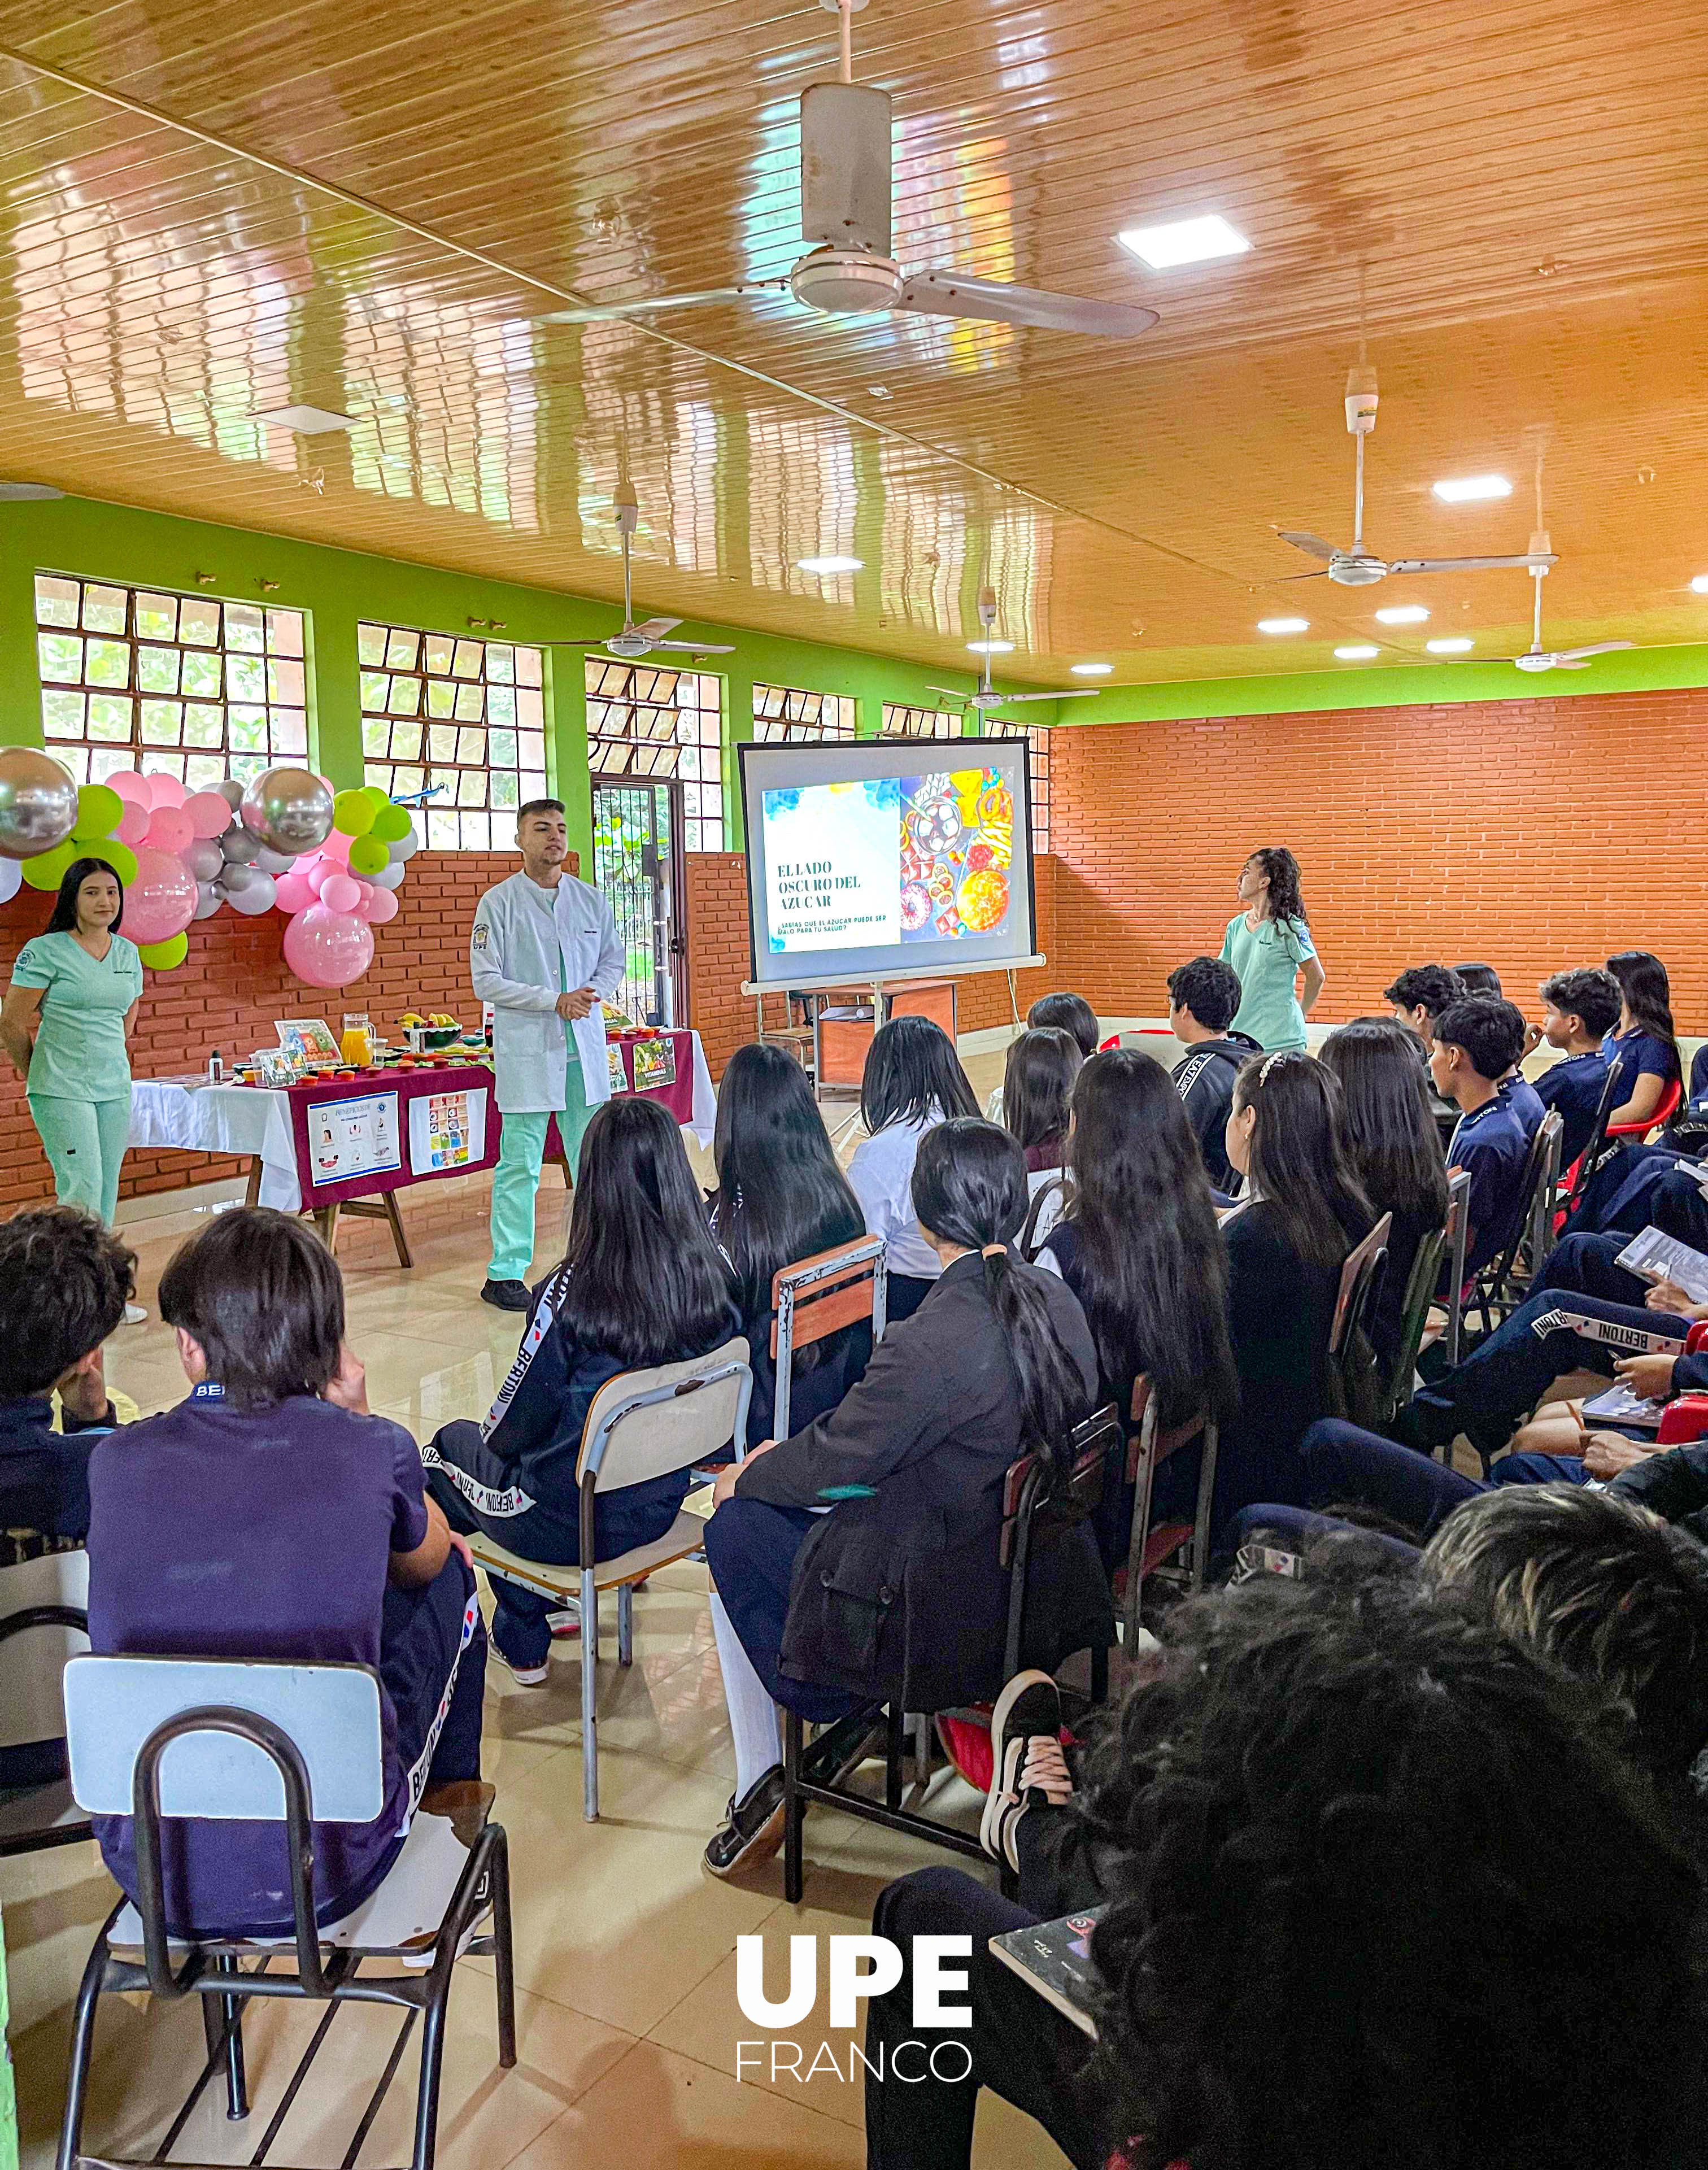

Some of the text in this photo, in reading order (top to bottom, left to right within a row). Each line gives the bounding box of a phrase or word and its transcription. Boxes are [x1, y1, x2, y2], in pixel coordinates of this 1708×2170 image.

[778, 861, 832, 877] EL LADO
[778, 876, 861, 894] OSCURO DEL
[781, 895, 831, 910] AZUCAR
[1599, 1323, 1649, 1349] BERTONI
[497, 1349, 533, 1404] BERTONI
